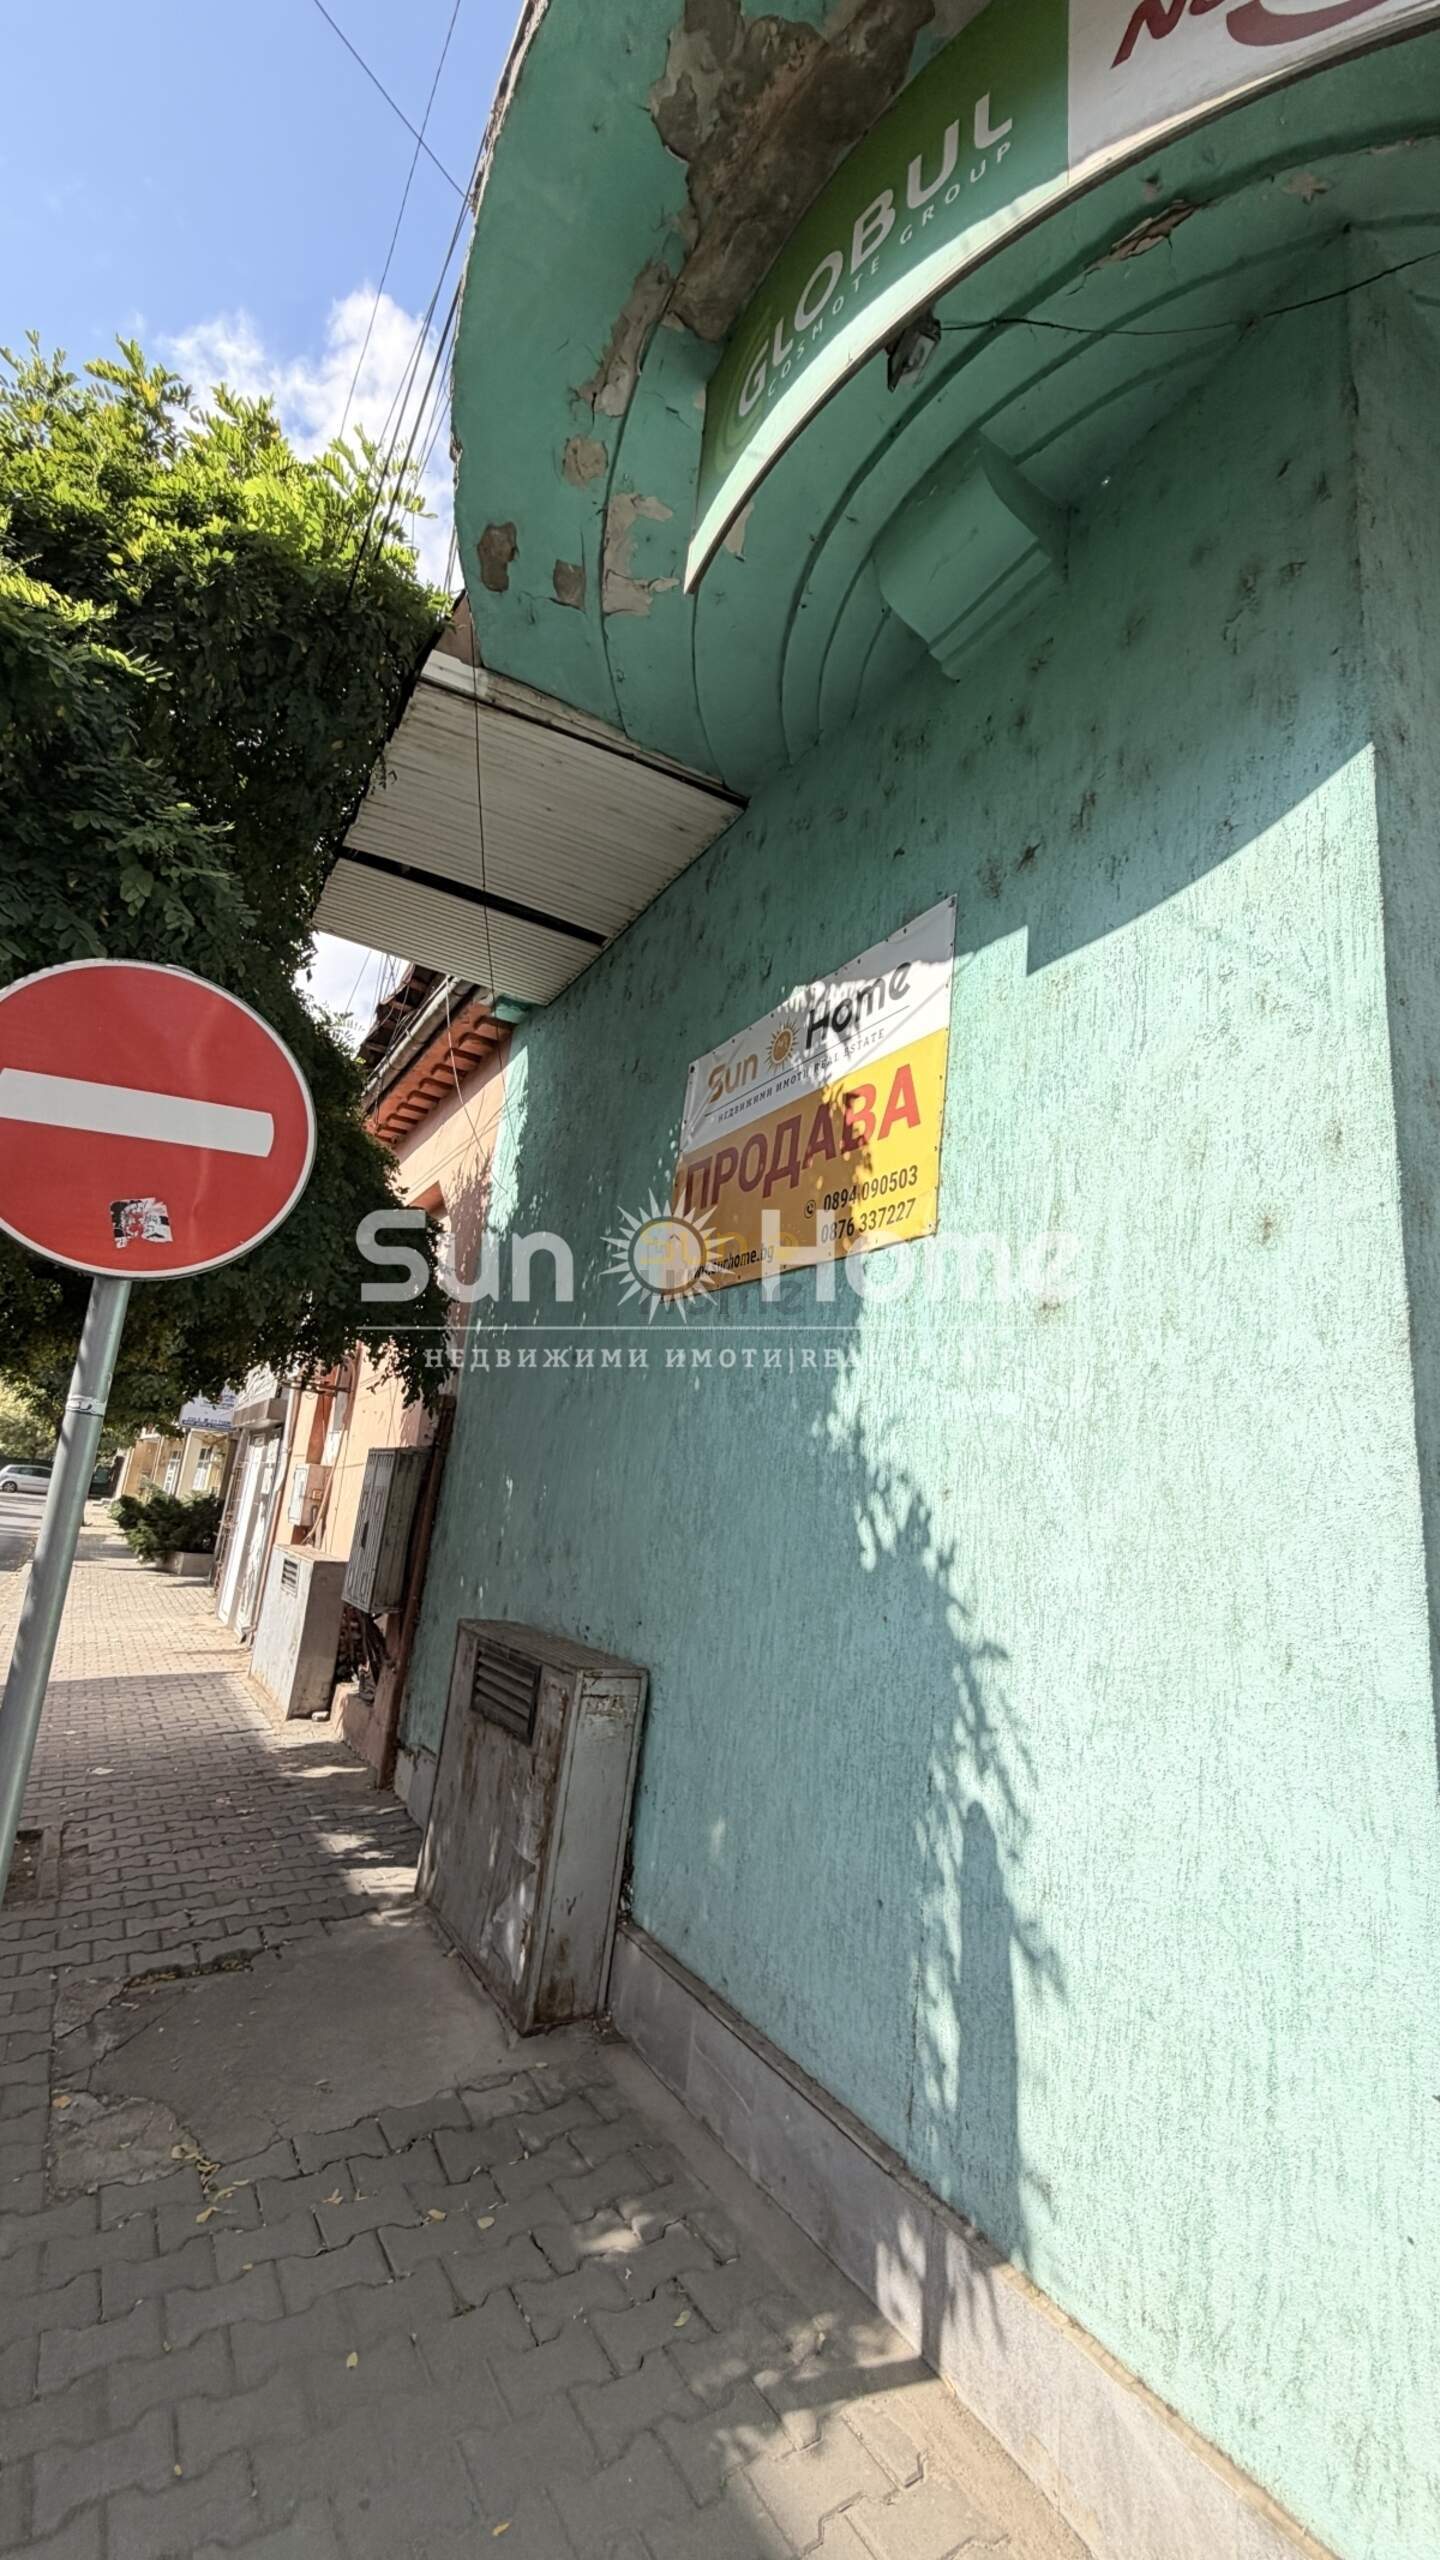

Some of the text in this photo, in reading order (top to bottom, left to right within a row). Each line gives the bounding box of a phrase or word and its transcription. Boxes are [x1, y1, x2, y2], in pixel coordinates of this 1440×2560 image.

[738, 92, 1013, 417] GLOBUL
[768, 142, 1010, 397] COSMOTE GROUP
[708, 962, 911, 1104] Sun Home
[684, 1063, 921, 1217] ПРОДАВА
[823, 1164, 918, 1212] 0894 090503
[820, 1197, 916, 1245] 0876 337227
